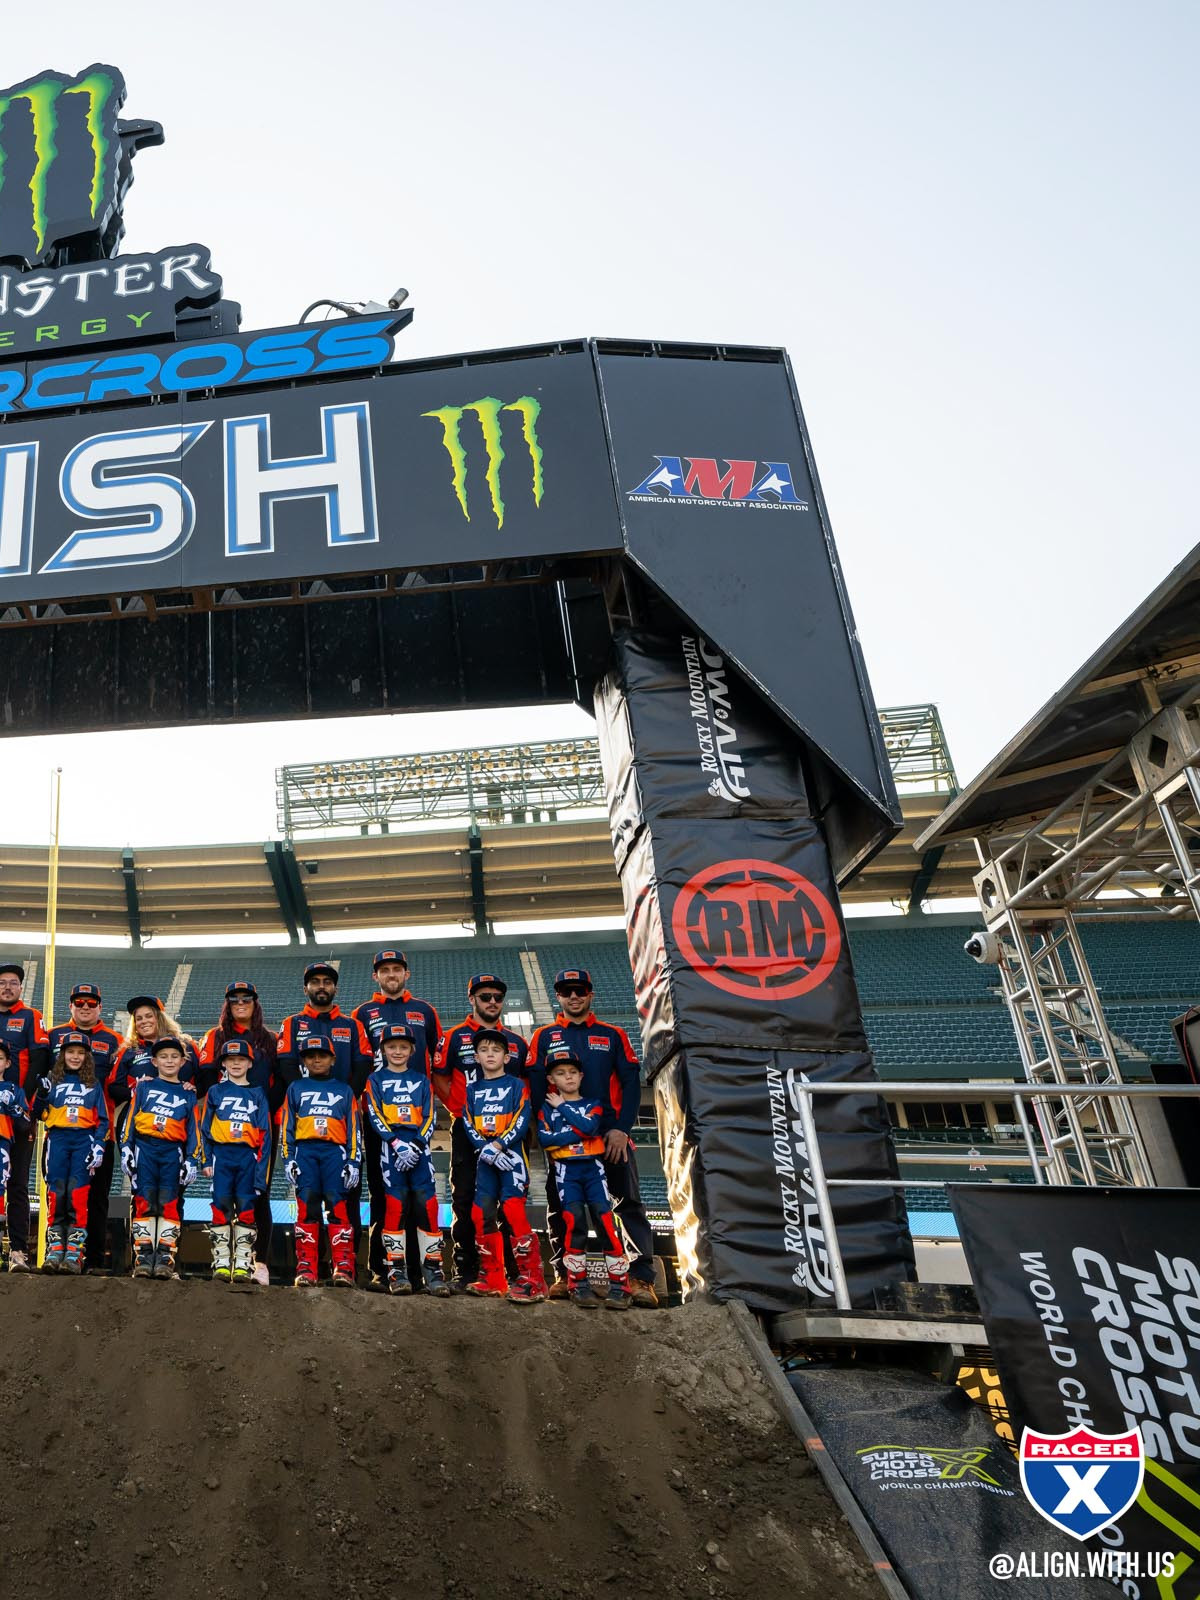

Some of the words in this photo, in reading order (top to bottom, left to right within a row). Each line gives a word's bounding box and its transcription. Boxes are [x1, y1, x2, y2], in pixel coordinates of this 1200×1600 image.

[625, 455, 809, 505] AMA
[628, 495, 676, 504] AMERICAN
[677, 498, 747, 508] MOTORCYCLIST
[749, 502, 809, 512] ASSOCIATION
[681, 635, 709, 721] MOUNTAIN
[697, 722, 720, 775] ROCKY
[702, 899, 810, 959] RM
[55, 1083, 95, 1098] FLY
[381, 1079, 422, 1094] FLY
[63, 1096, 85, 1105] KTM
[146, 1089, 188, 1108] FLY
[300, 1091, 344, 1107] FLY
[391, 1094, 413, 1103] KTM
[474, 1086, 512, 1105] FLY
[150, 1105, 175, 1117] KTM
[218, 1096, 259, 1114] FLY
[308, 1106, 333, 1116] KTM
[481, 1103, 503, 1114] KTM
[228, 1111, 251, 1122] KTM
[766, 1066, 796, 1182] MOUNTAIN
[503, 1130, 517, 1147] FLY
[780, 1182, 806, 1258] ROCKY
[1019, 1250, 1077, 1369] WORLD
[1072, 1247, 1174, 1464] CROSS
[861, 1450, 934, 1465] SUPER
[870, 1459, 936, 1472] MOTO
[870, 1467, 942, 1480] CROSS
[879, 1482, 922, 1492] WORLD
[924, 1480, 1015, 1497] CHAMPIONSHIP
